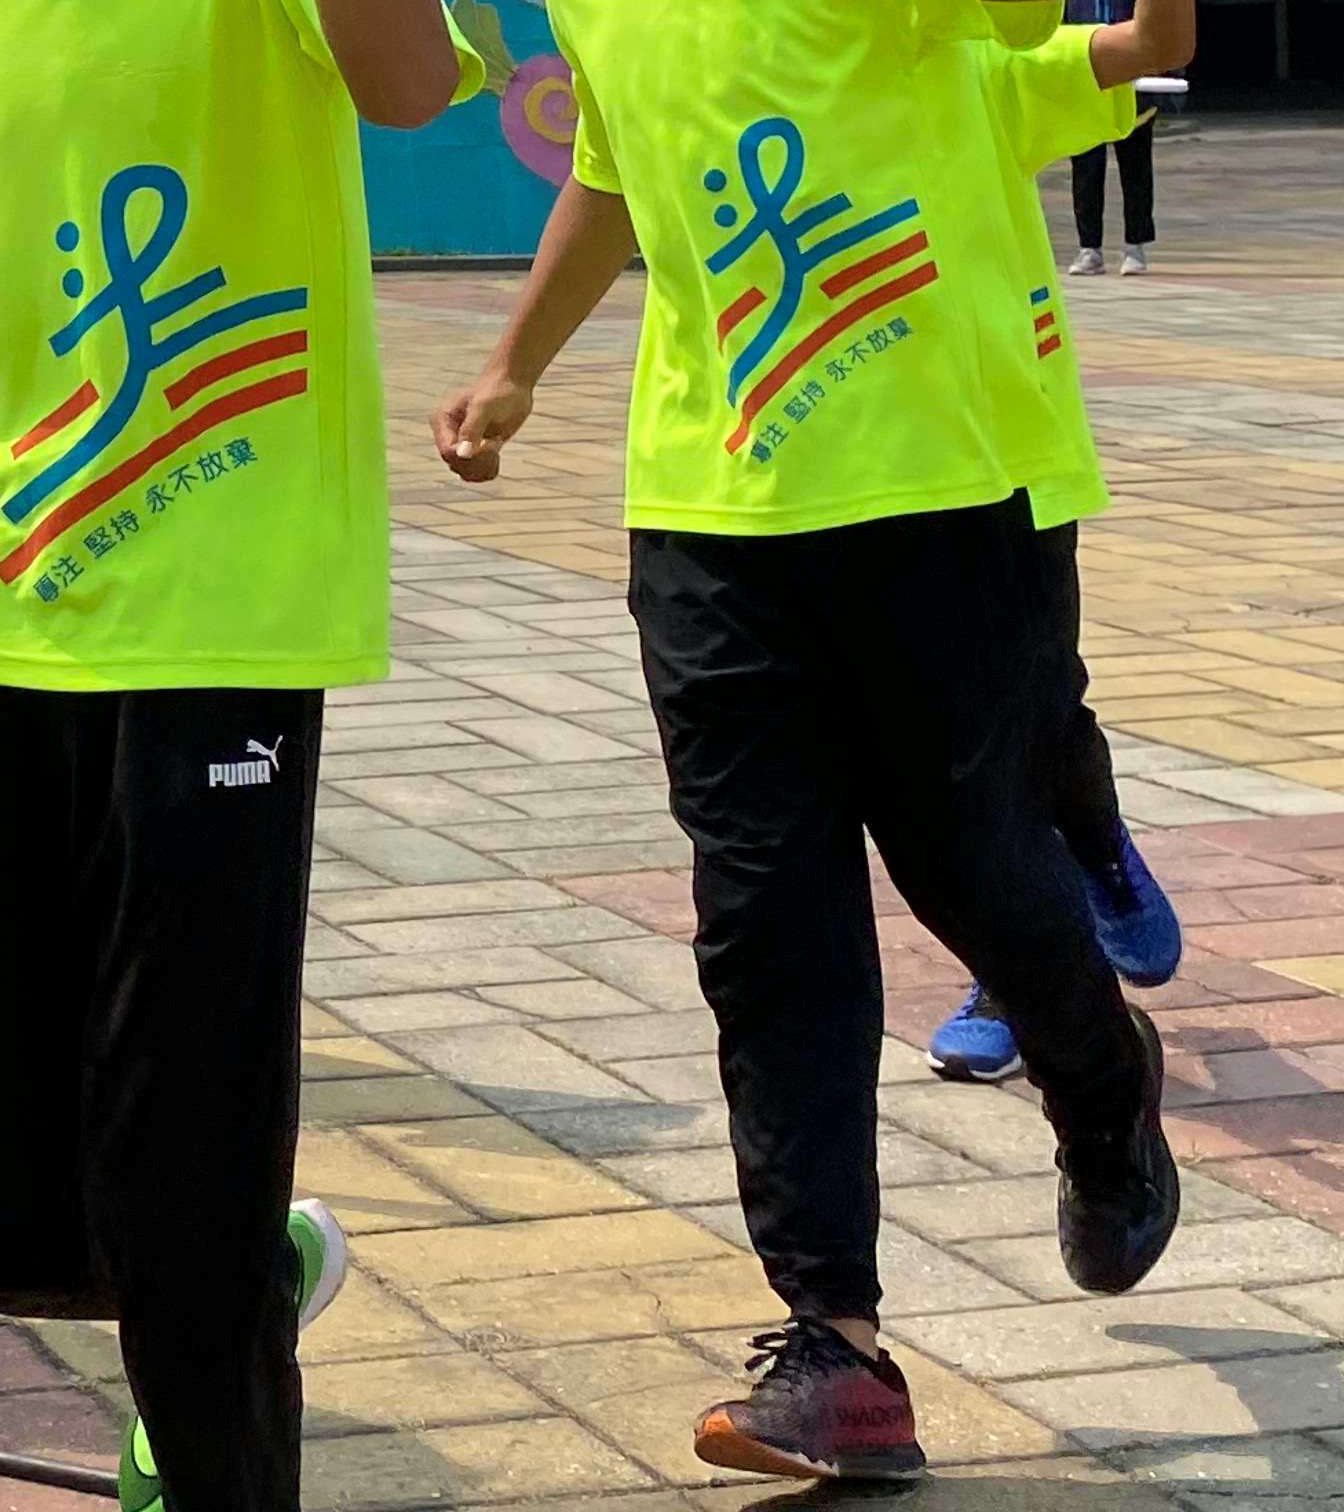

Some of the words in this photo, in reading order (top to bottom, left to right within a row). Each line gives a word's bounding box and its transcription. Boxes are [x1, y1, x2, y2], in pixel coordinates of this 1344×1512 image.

[824, 316, 913, 383] 永不放棄
[32, 554, 85, 603] 專注
[83, 509, 141, 560] 堅持
[144, 436, 258, 514] 永不放棄
[208, 759, 271, 788] PUMA
